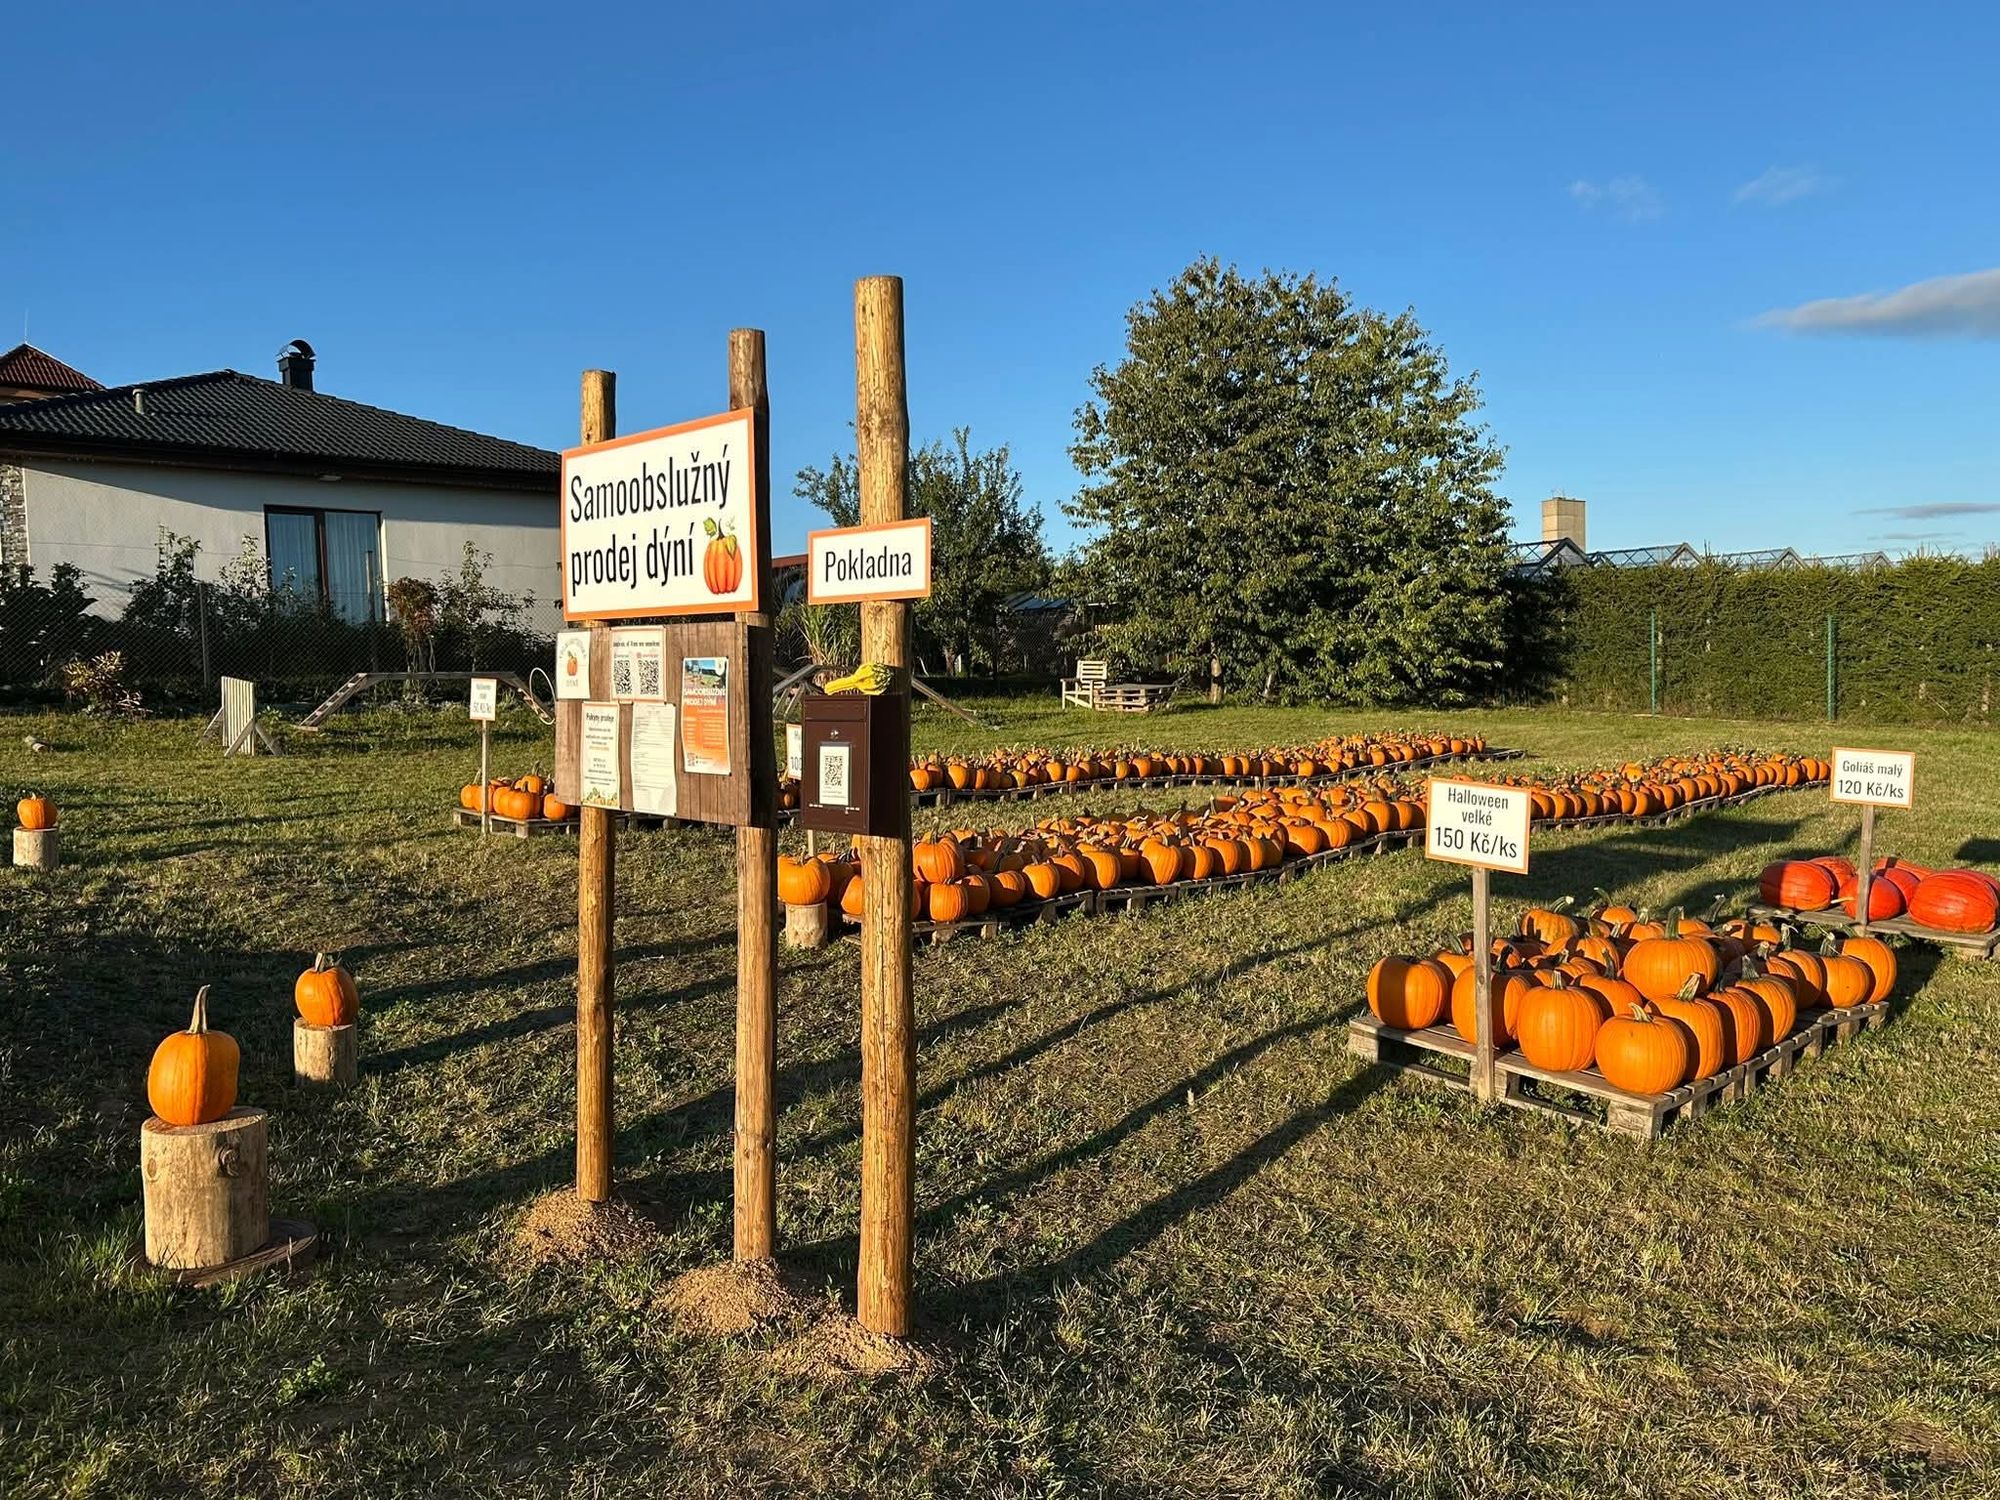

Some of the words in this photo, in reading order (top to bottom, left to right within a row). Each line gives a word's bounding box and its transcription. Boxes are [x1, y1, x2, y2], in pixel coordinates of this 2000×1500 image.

[570, 443, 731, 523] Samoobslužný
[571, 533, 638, 597] prodej
[646, 521, 695, 587] dýní
[825, 545, 912, 583] Pokladna
[1842, 760, 1874, 774] Goliáš
[1877, 763, 1903, 778] malý
[1448, 787, 1509, 810] Halloween
[1838, 779, 1862, 795] 120
[1866, 781, 1904, 798] Kč/ks
[1461, 809, 1492, 826] velké
[1435, 826, 1464, 850] 150
[1470, 831, 1517, 858] Kč/ks
